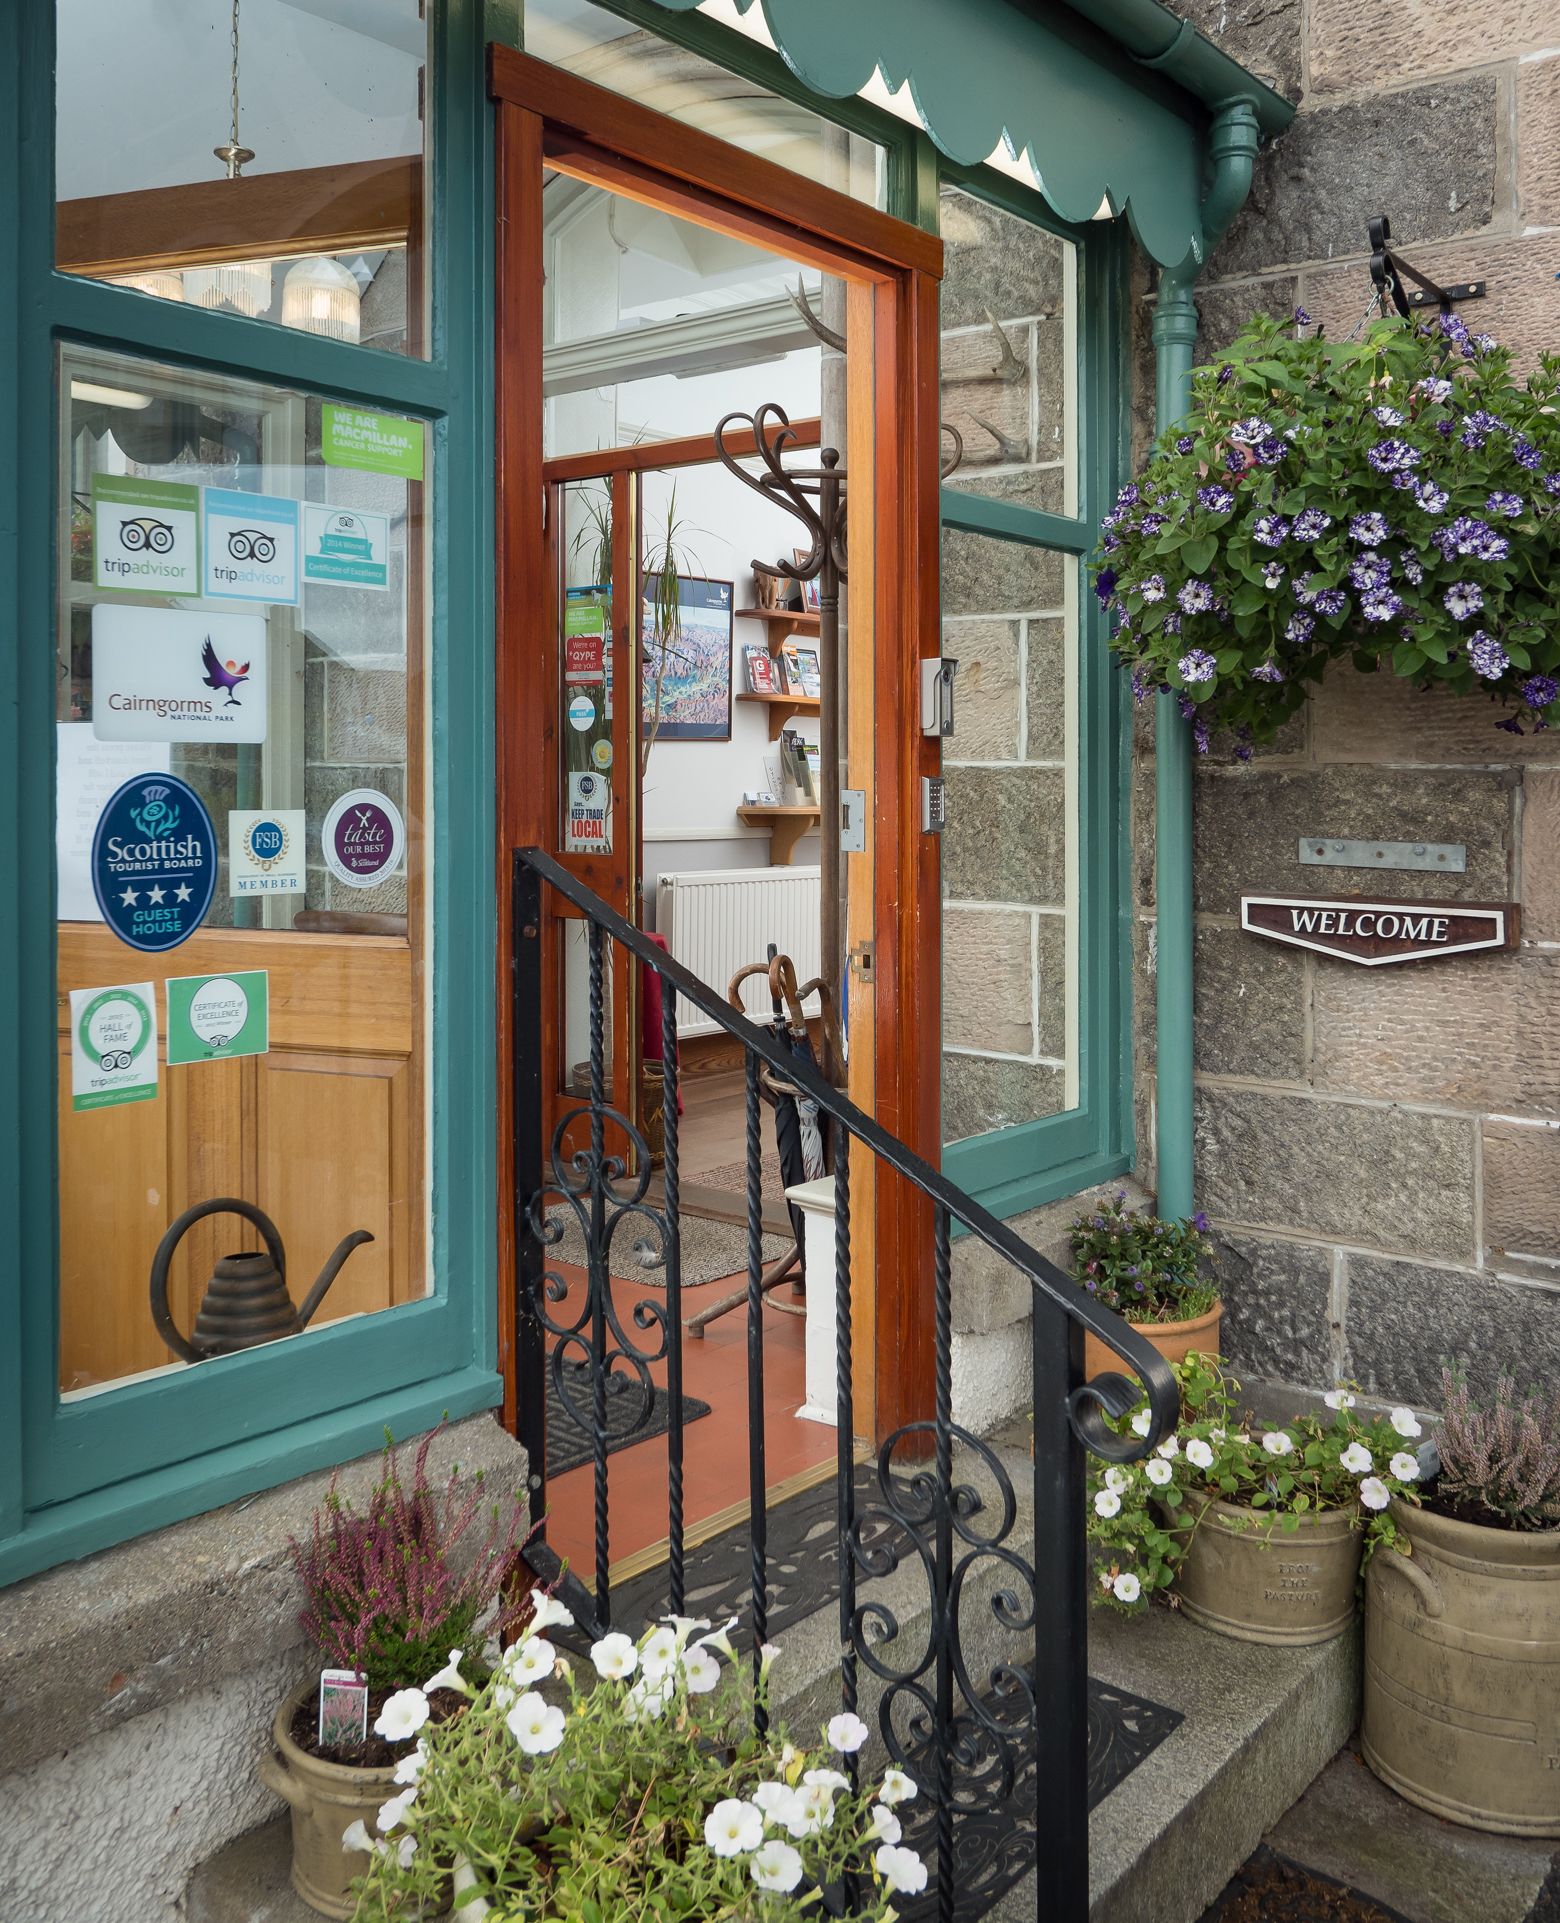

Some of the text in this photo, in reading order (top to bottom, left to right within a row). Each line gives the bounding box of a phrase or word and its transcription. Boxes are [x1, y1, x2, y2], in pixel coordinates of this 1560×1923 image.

[333, 410, 378, 430] WE ARE
[332, 438, 404, 457] CANCER SUPPORT
[103, 557, 187, 578] tripadvisor
[308, 562, 341, 574] Certificate
[213, 565, 287, 586] tripadvisor
[108, 693, 213, 718] Cairngorms
[170, 714, 212, 722] NATIONAL
[571, 808, 604, 820] KEEP TRADE
[343, 822, 388, 843] taste
[571, 819, 604, 839] LOCAL
[254, 831, 280, 849] FSB
[106, 834, 203, 863] Scottish
[343, 843, 385, 855] OUR BEST
[108, 858, 203, 872] TOURIST BOARD
[237, 878, 297, 891] MEMBER
[132, 907, 181, 922] GUEST
[132, 920, 182, 936] HOUSE
[1290, 909, 1450, 943] WELCOME
[193, 1000, 236, 1012] CERTIFICATE
[196, 1009, 240, 1021] EXCELLENCE
[99, 1023, 124, 1033] HALL
[103, 1032, 129, 1044] FAME
[90, 1073, 142, 1088] tripadvisor
